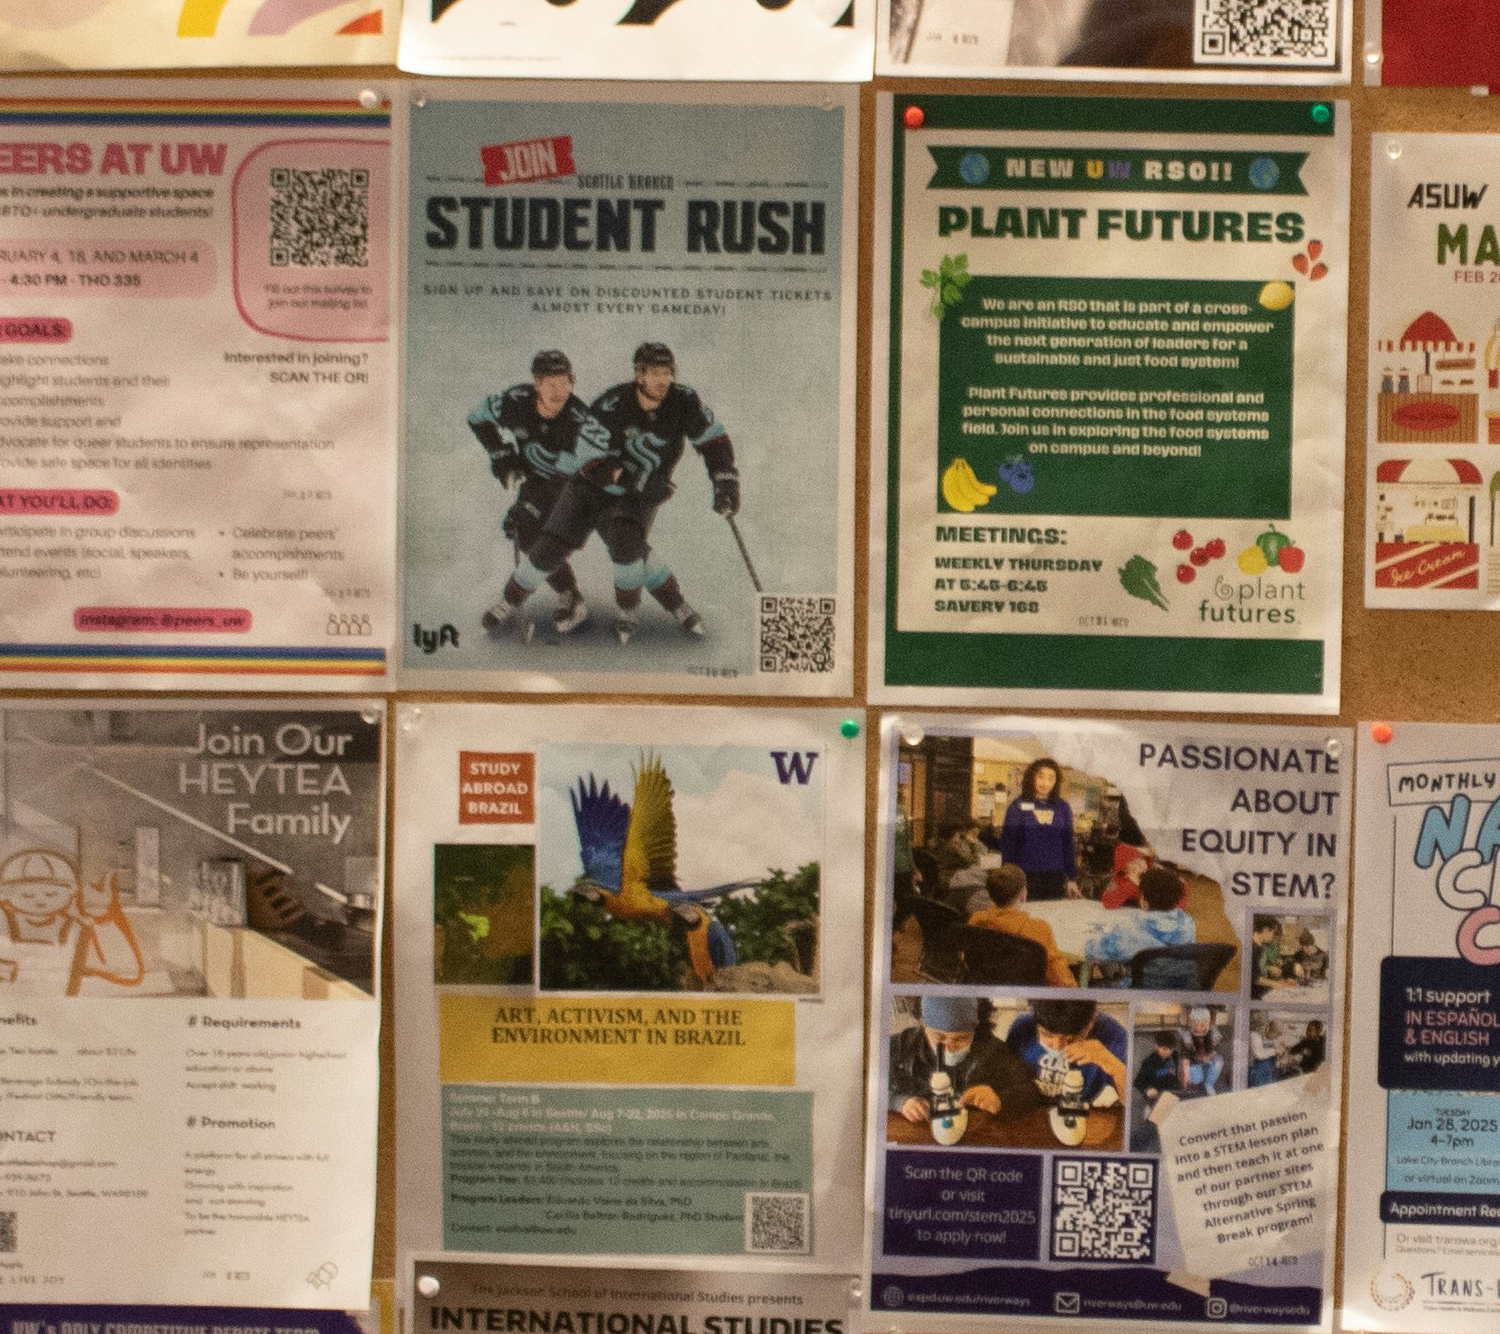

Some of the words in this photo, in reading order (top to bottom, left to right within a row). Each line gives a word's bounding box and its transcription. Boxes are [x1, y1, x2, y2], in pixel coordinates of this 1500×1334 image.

[102, 143, 153, 176] AT
[160, 143, 228, 176] UW
[500, 142, 557, 183] JOIN
[426, 198, 663, 255] STUDENT
[687, 201, 825, 256] RUSH
[938, 207, 1089, 241] PLANT
[1100, 210, 1305, 246] FUTURES
[936, 526, 1068, 547] MEETINGS:
[1140, 744, 1341, 776] PASSIONATE
[179, 762, 353, 797] HEYTEA
[1182, 830, 1295, 858] EQUITY
[1307, 831, 1337, 858] IN
[1232, 872, 1335, 900] STEM?
